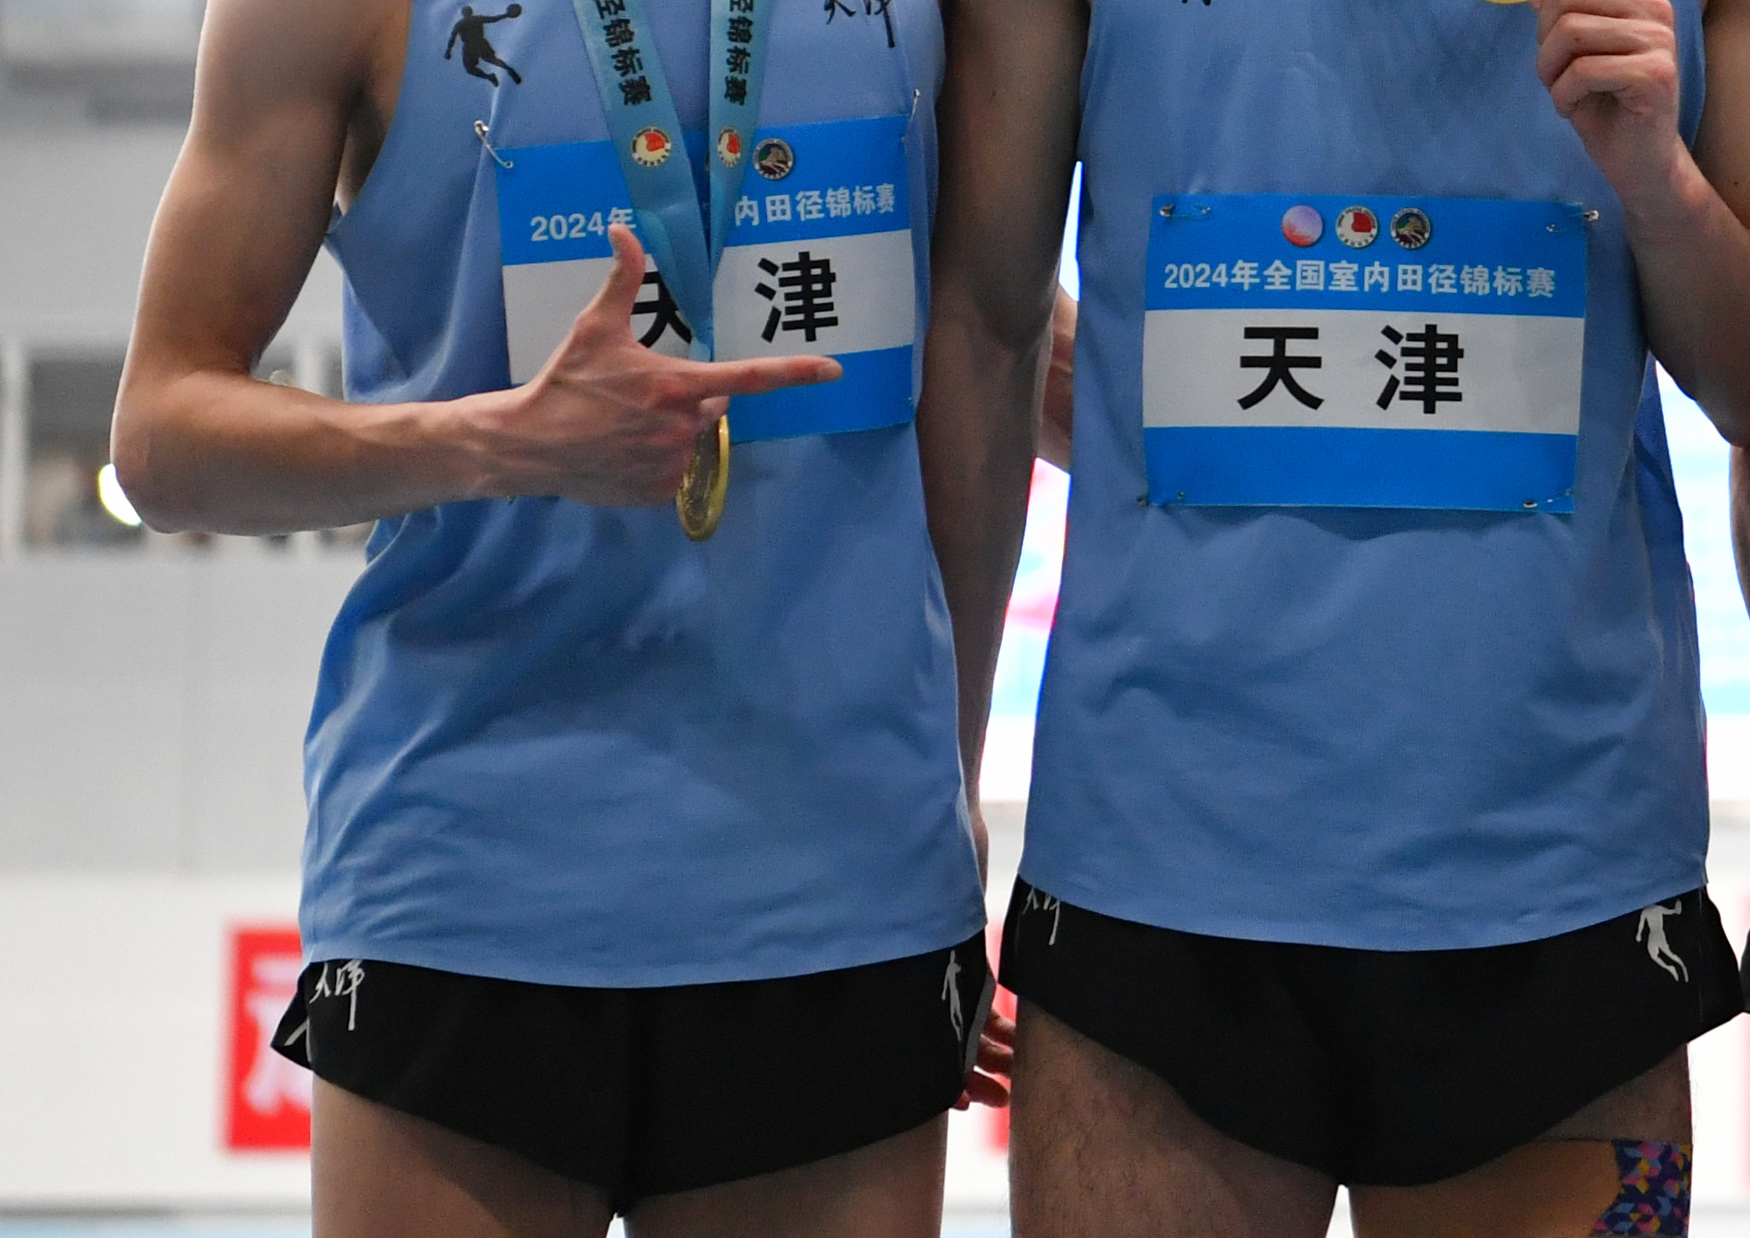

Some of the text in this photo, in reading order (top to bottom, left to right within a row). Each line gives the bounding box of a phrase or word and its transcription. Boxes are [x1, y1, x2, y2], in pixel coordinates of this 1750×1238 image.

[1163, 259, 1556, 299] 2024年全国室内田径锦标赛
[1236, 323, 1465, 415] 天津
